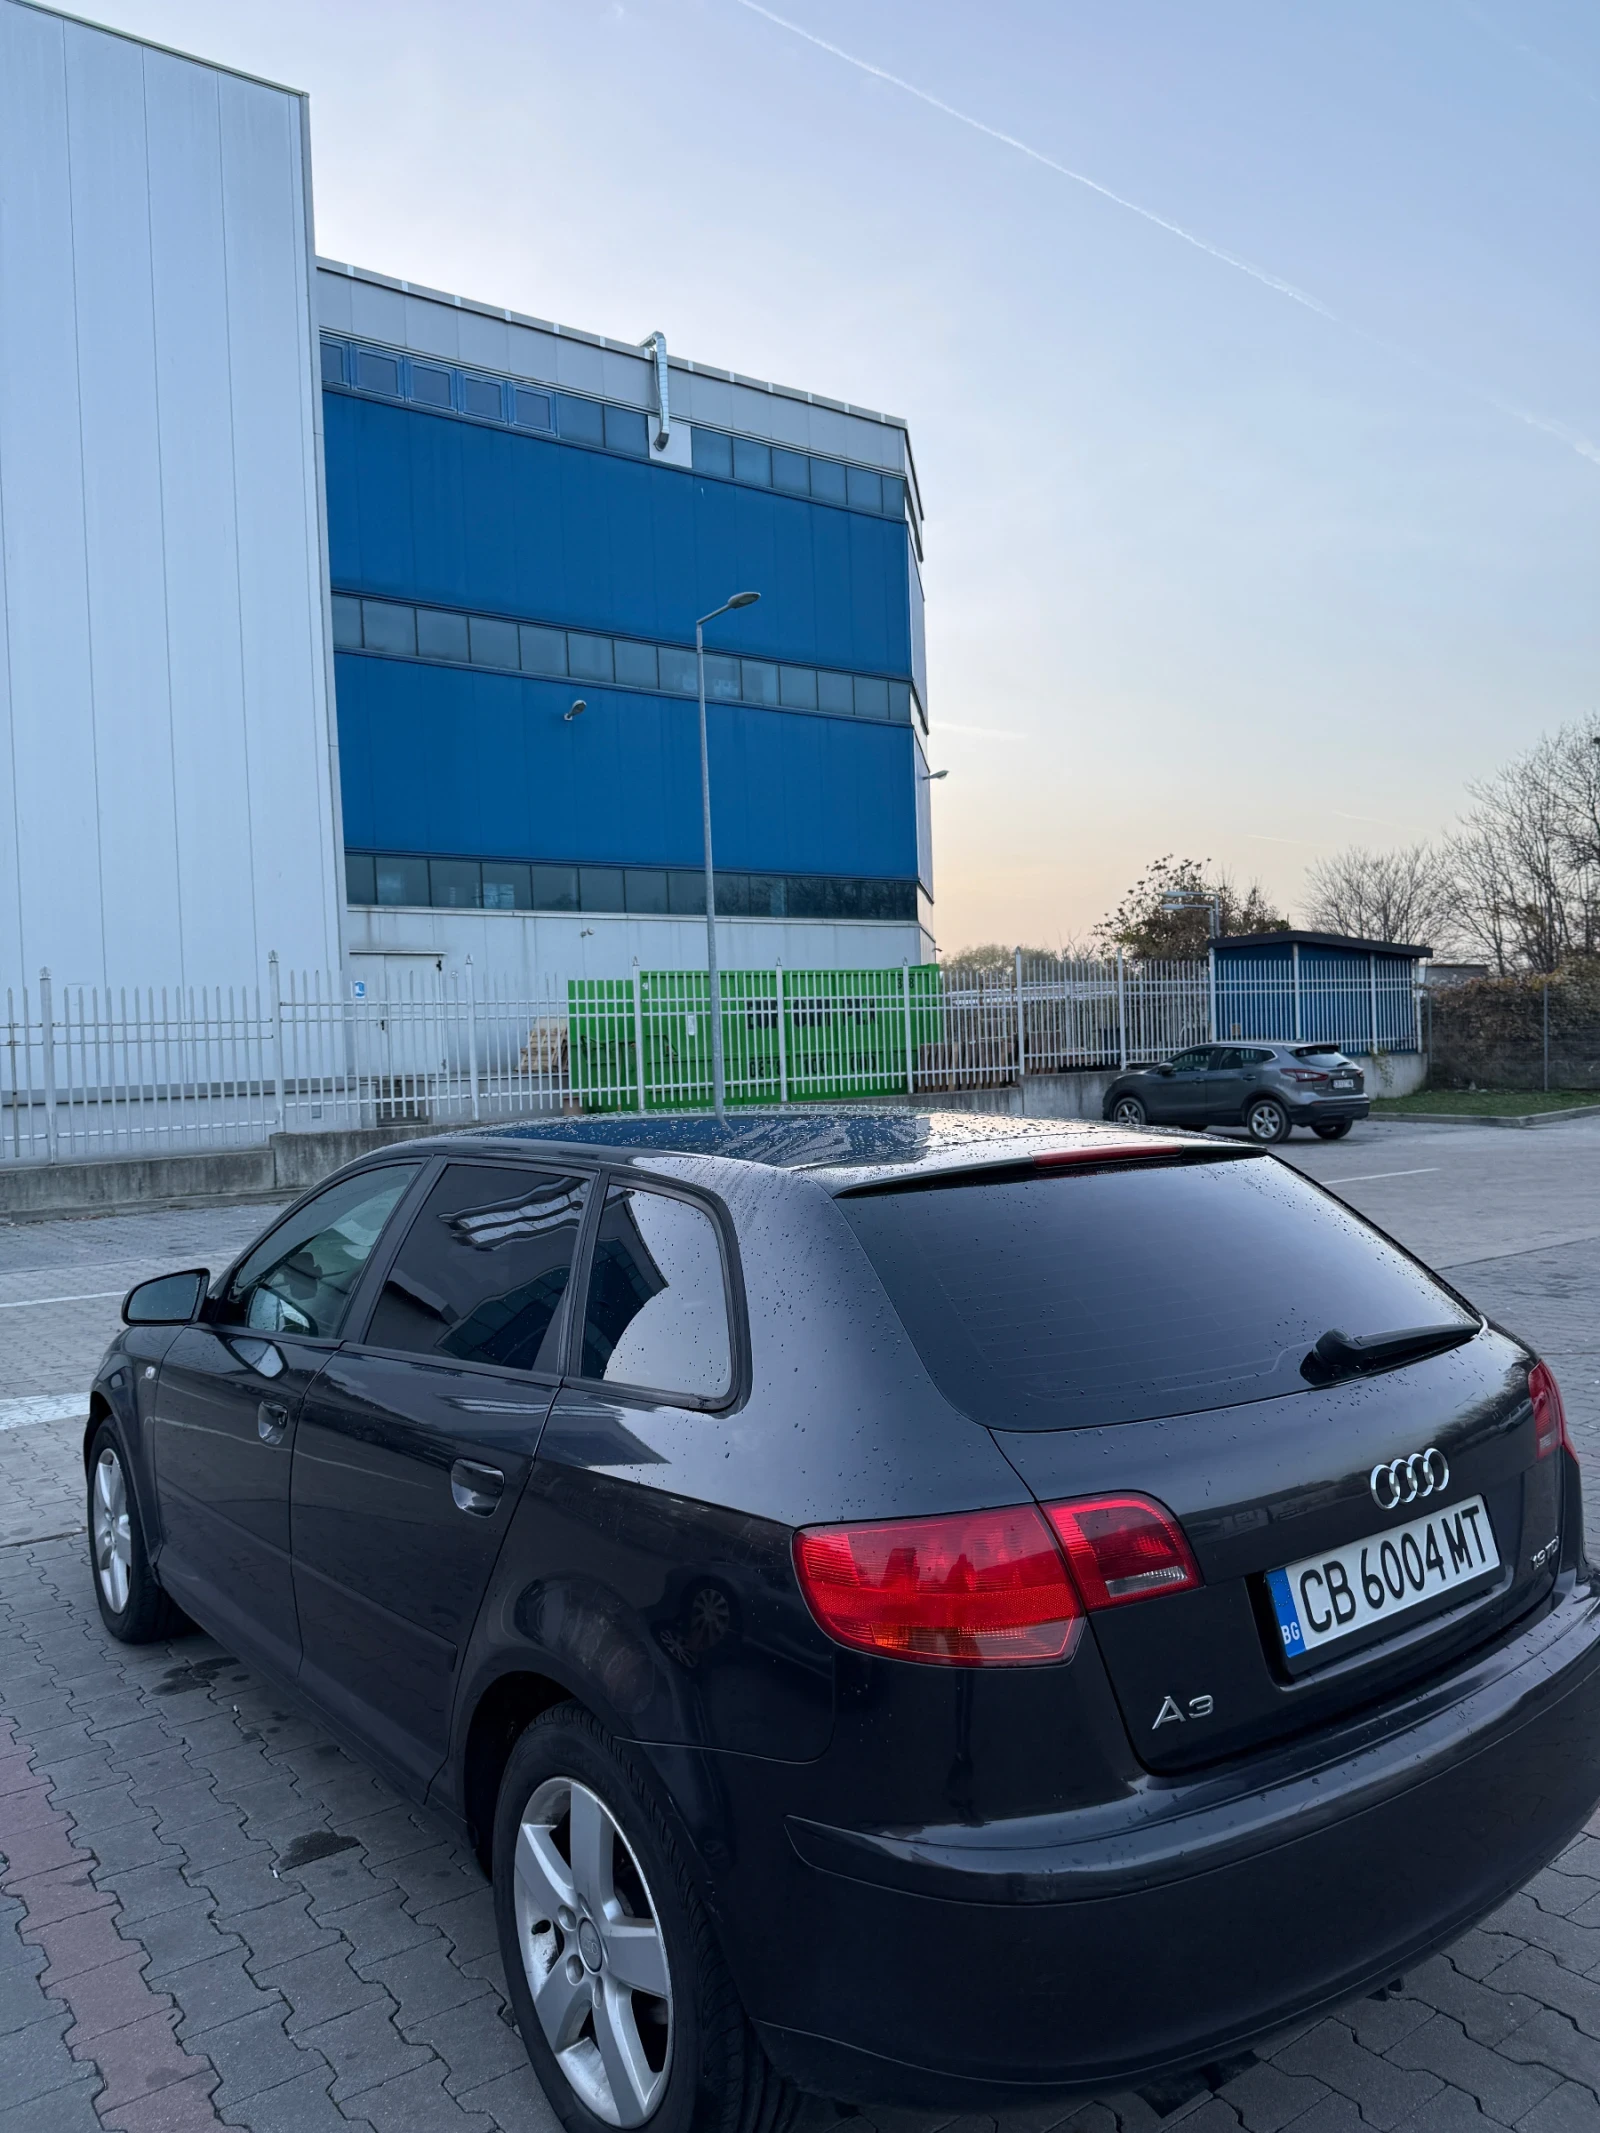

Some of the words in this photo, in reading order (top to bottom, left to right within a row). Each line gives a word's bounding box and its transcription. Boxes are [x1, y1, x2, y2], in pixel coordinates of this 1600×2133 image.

[1300, 1560, 1356, 1633] CB
[1360, 1523, 1446, 1610] 6004
[1441, 1505, 1480, 1575] MT
[1281, 1621, 1300, 1644] BG
[1151, 1694, 1214, 1730] A3
